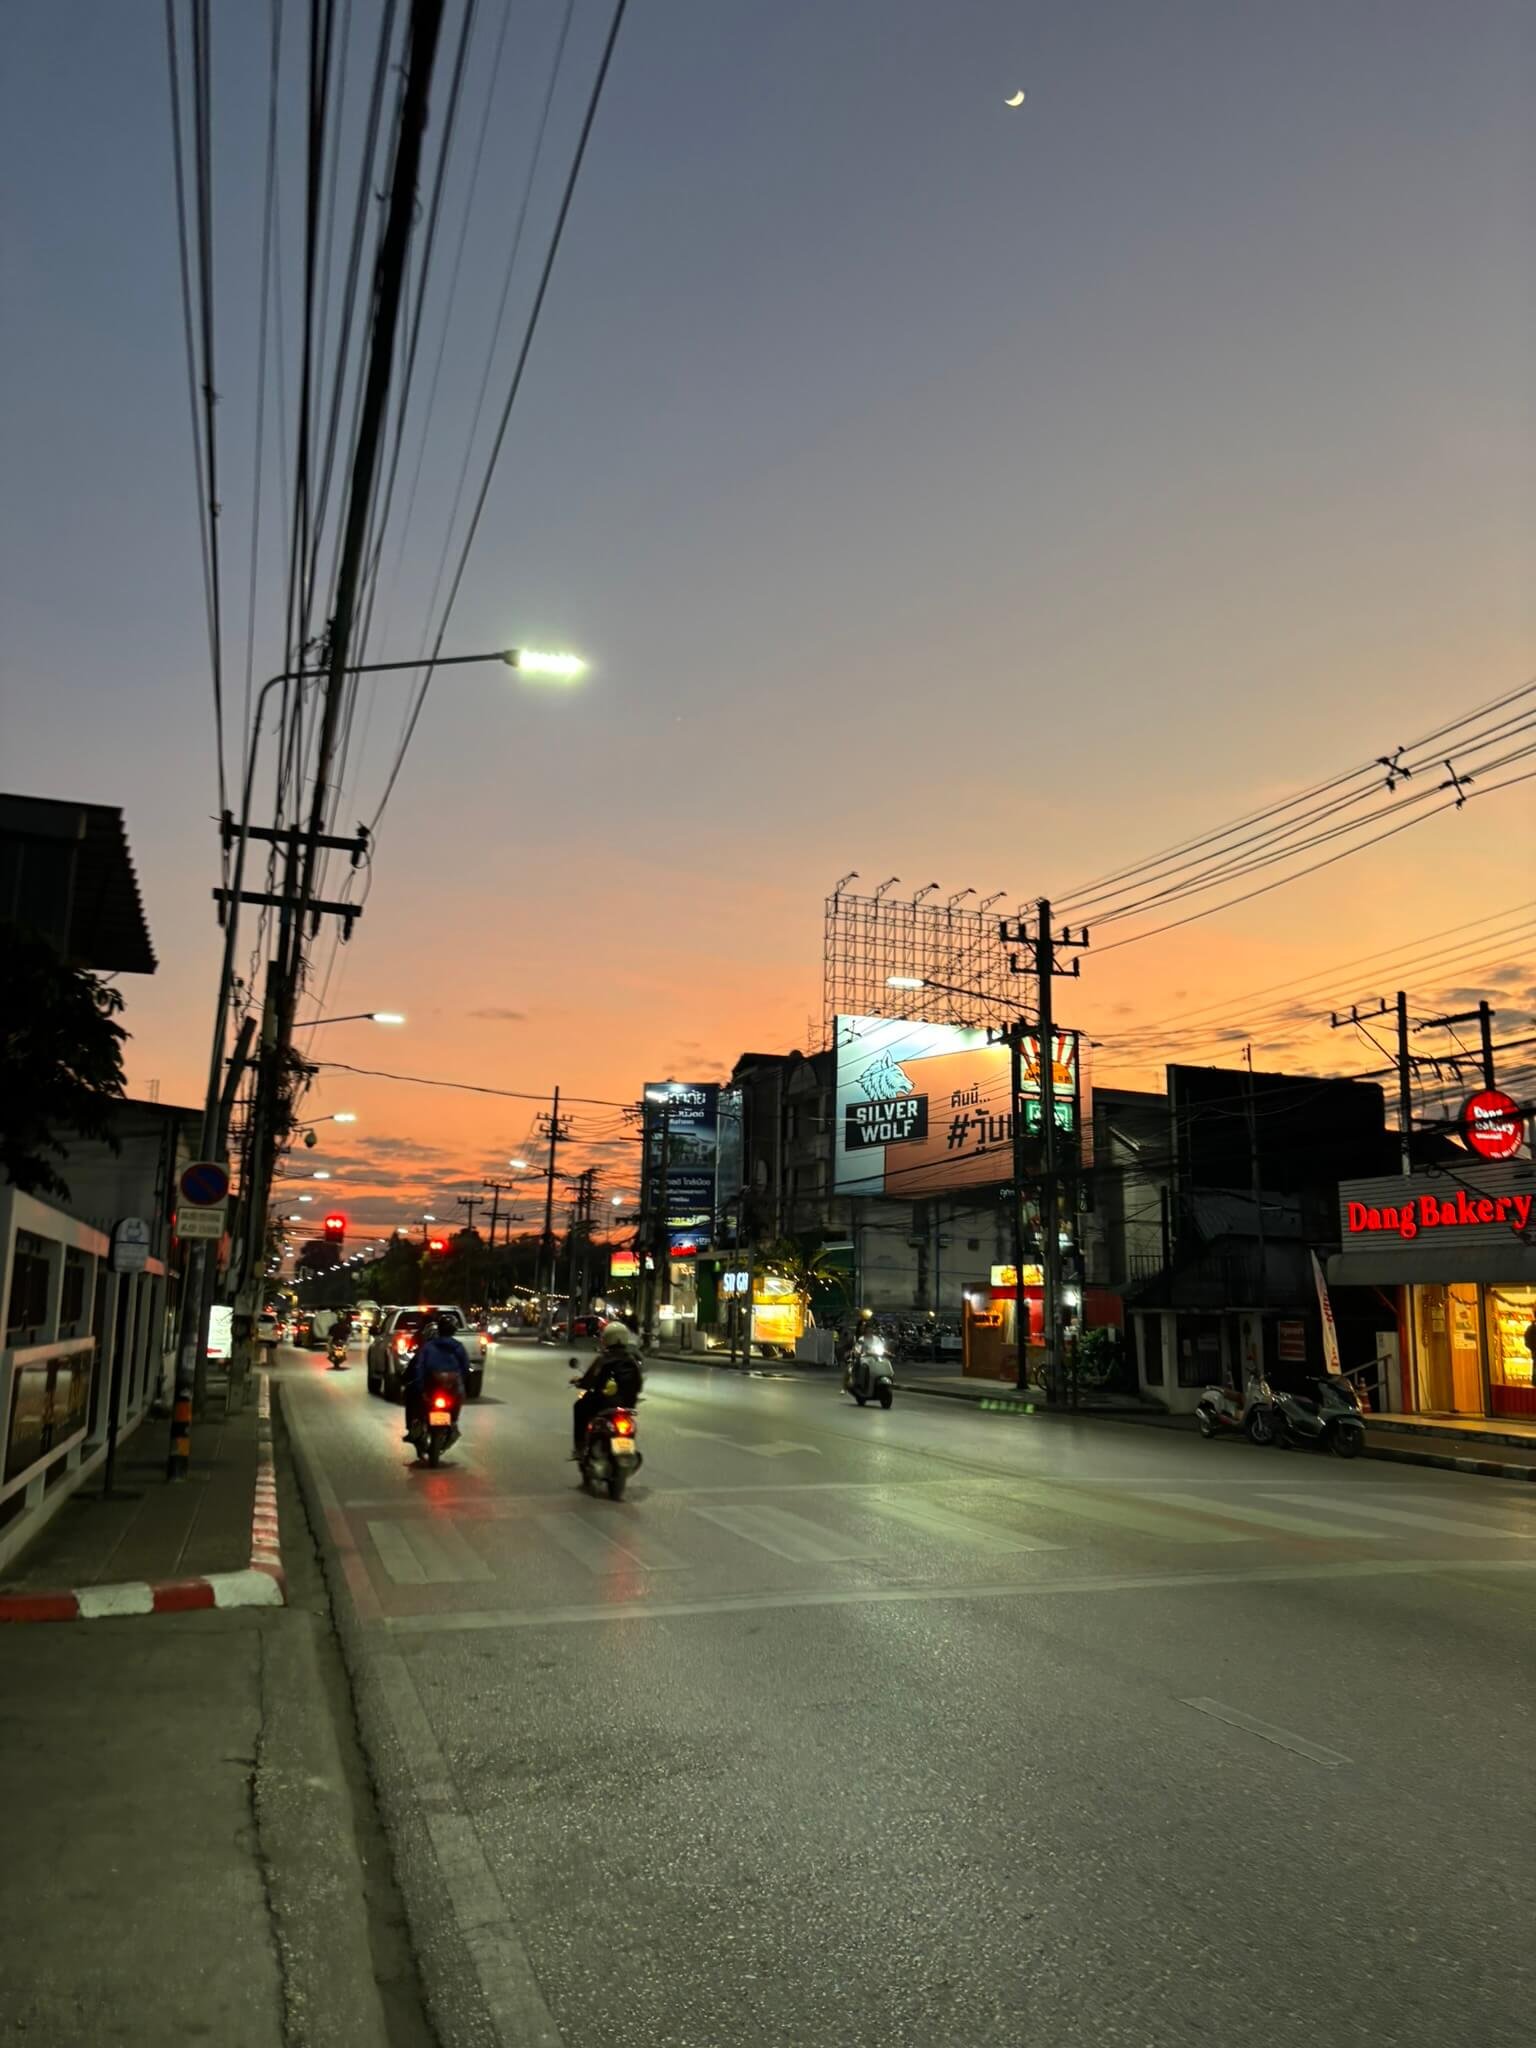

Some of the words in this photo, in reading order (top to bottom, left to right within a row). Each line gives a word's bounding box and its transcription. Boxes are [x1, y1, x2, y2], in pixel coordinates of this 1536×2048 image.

[856, 1100, 918, 1124] SILVER
[861, 1119, 914, 1143] WOLF
[1347, 1201, 1417, 1240] Dang
[1418, 1190, 1533, 1230] Bakery
